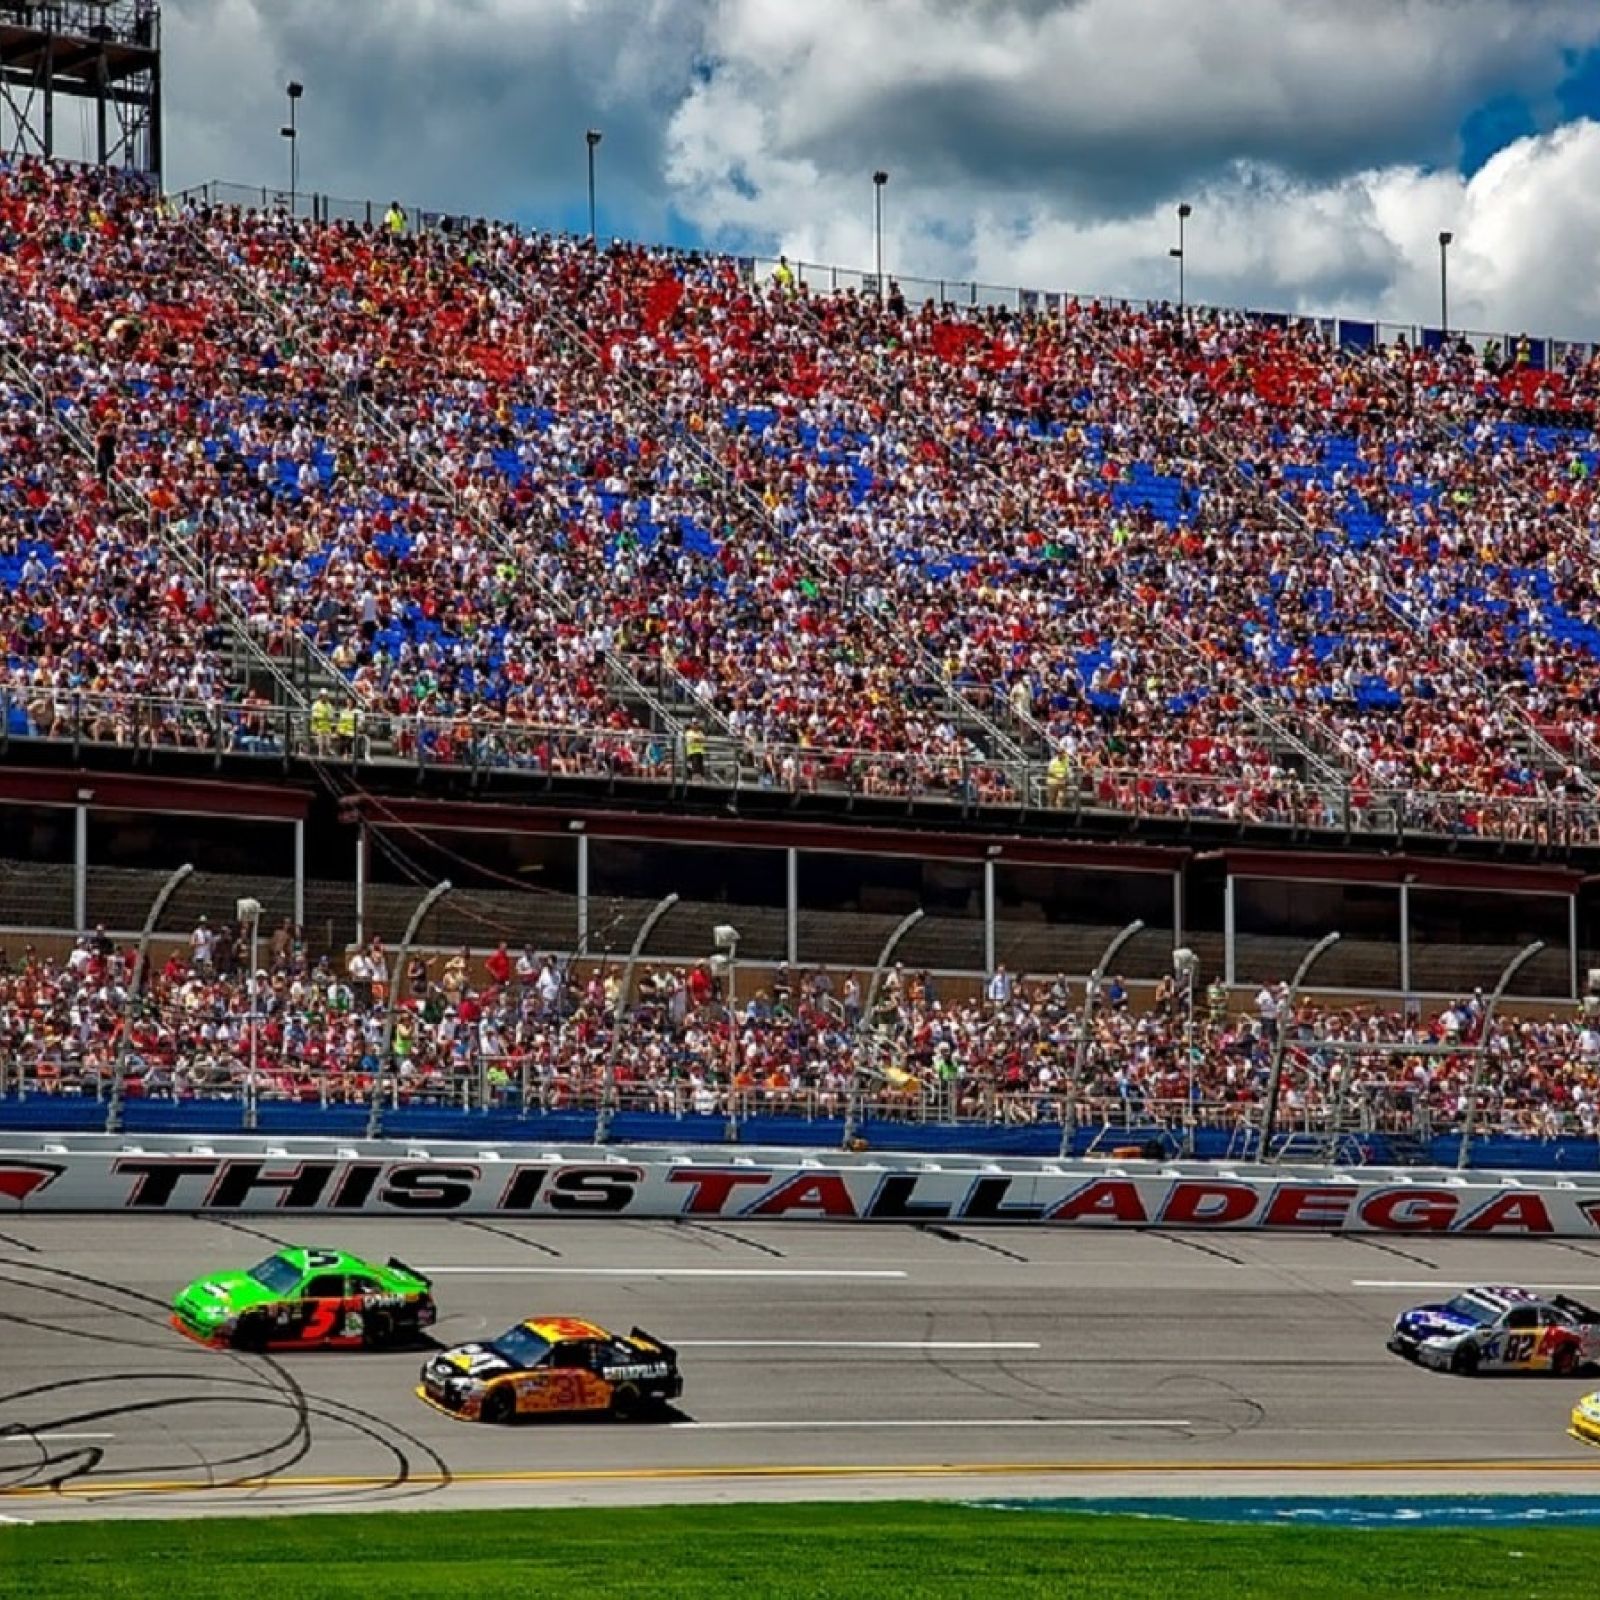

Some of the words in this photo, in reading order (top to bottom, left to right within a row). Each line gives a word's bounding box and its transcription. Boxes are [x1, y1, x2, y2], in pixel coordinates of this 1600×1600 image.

[111, 1157, 481, 1209] THIS
[497, 1163, 645, 1212] IS
[666, 1165, 1554, 1233] TALLADEGA
[303, 1298, 341, 1337] 5
[1504, 1333, 1535, 1363] 82
[551, 1371, 586, 1406] 31
